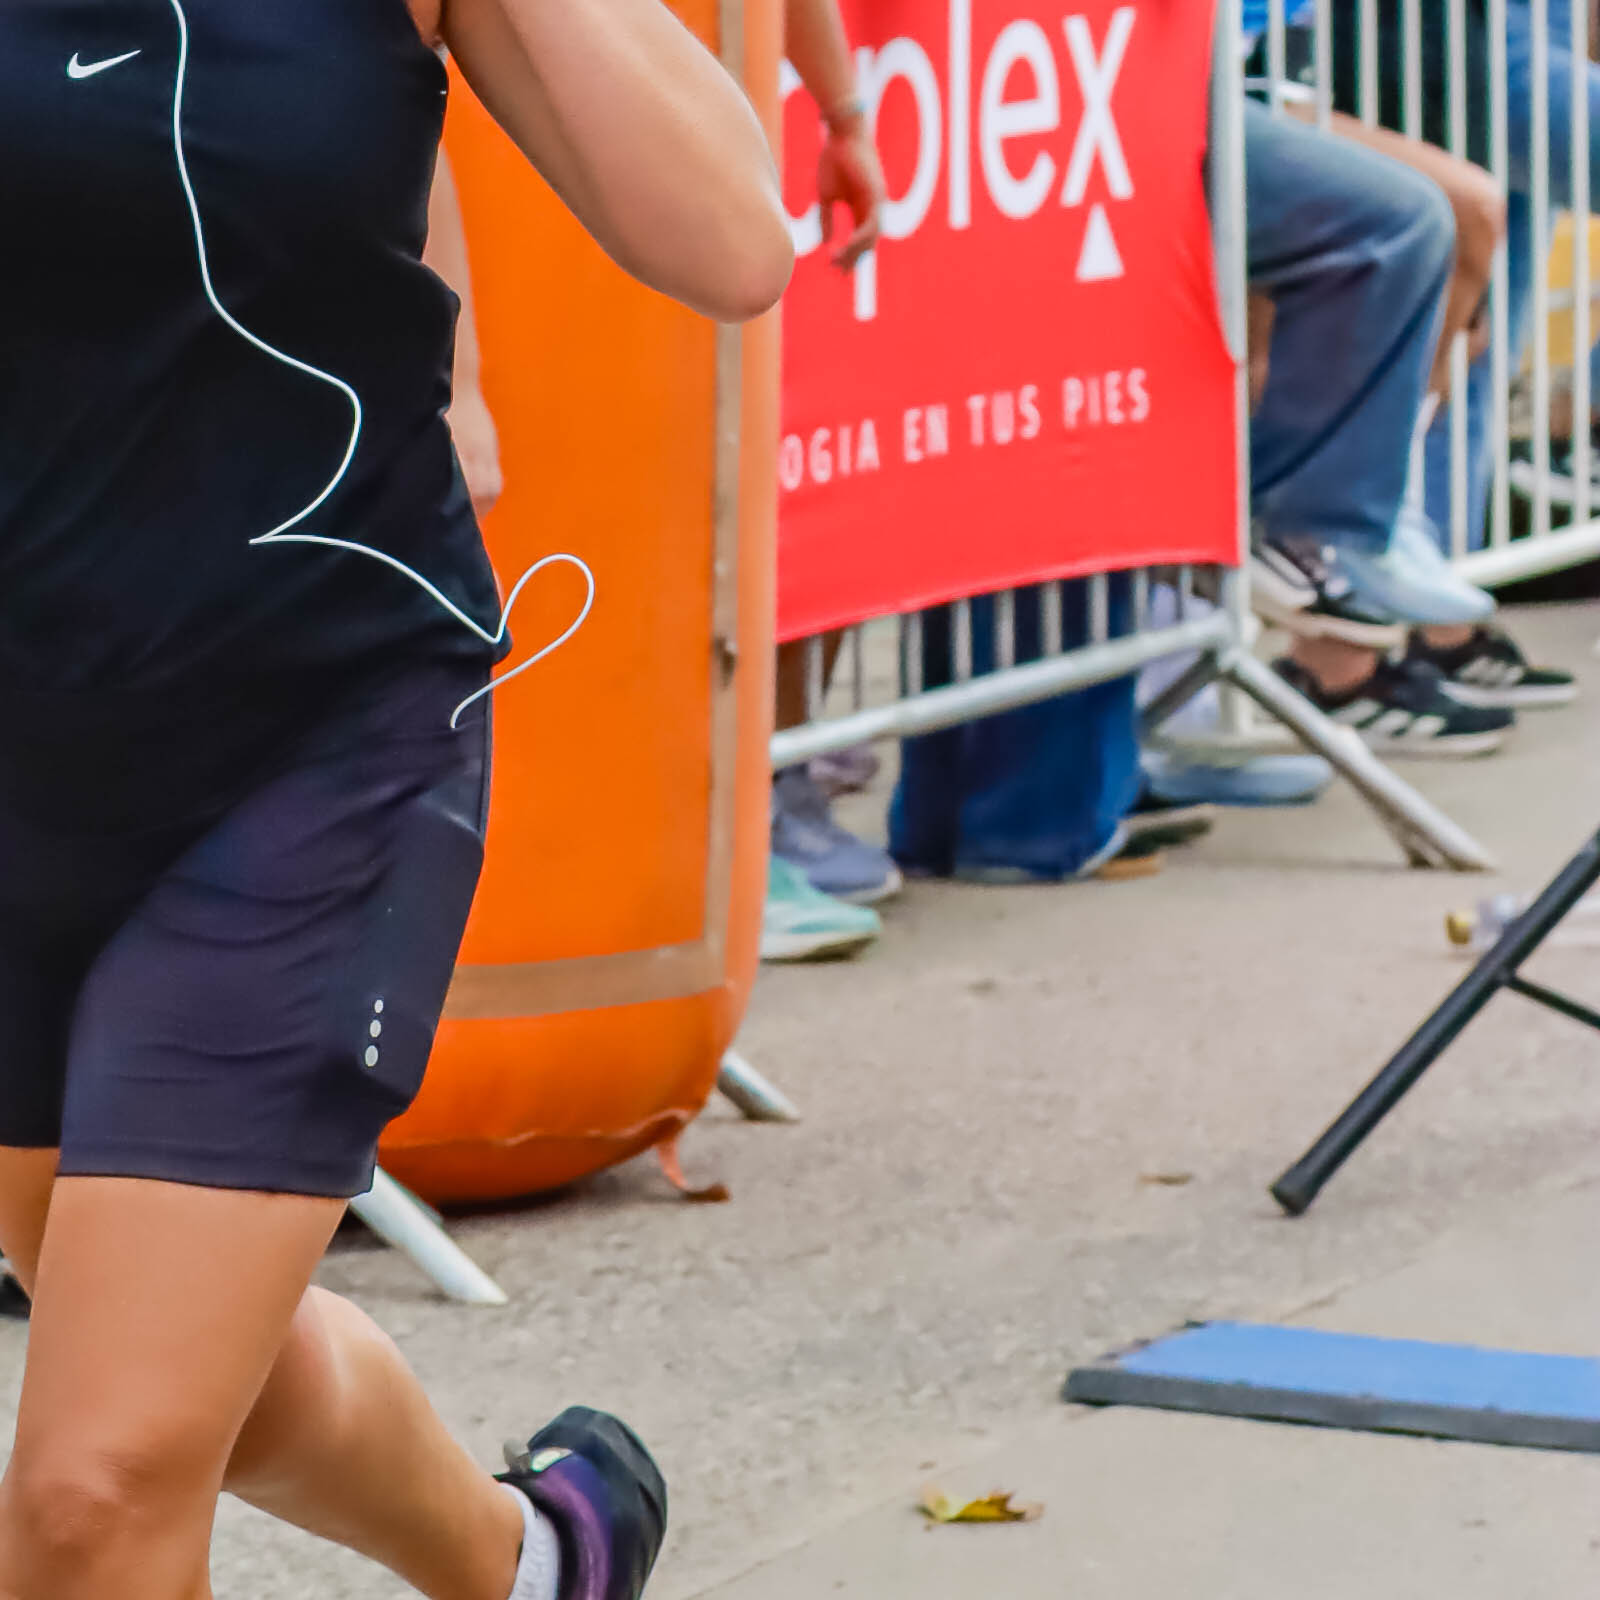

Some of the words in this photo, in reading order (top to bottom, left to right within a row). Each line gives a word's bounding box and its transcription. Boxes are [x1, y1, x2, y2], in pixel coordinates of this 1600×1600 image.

[903, 403, 949, 462] EN
[968, 385, 1040, 447] TUS
[1063, 368, 1150, 430] PIES
